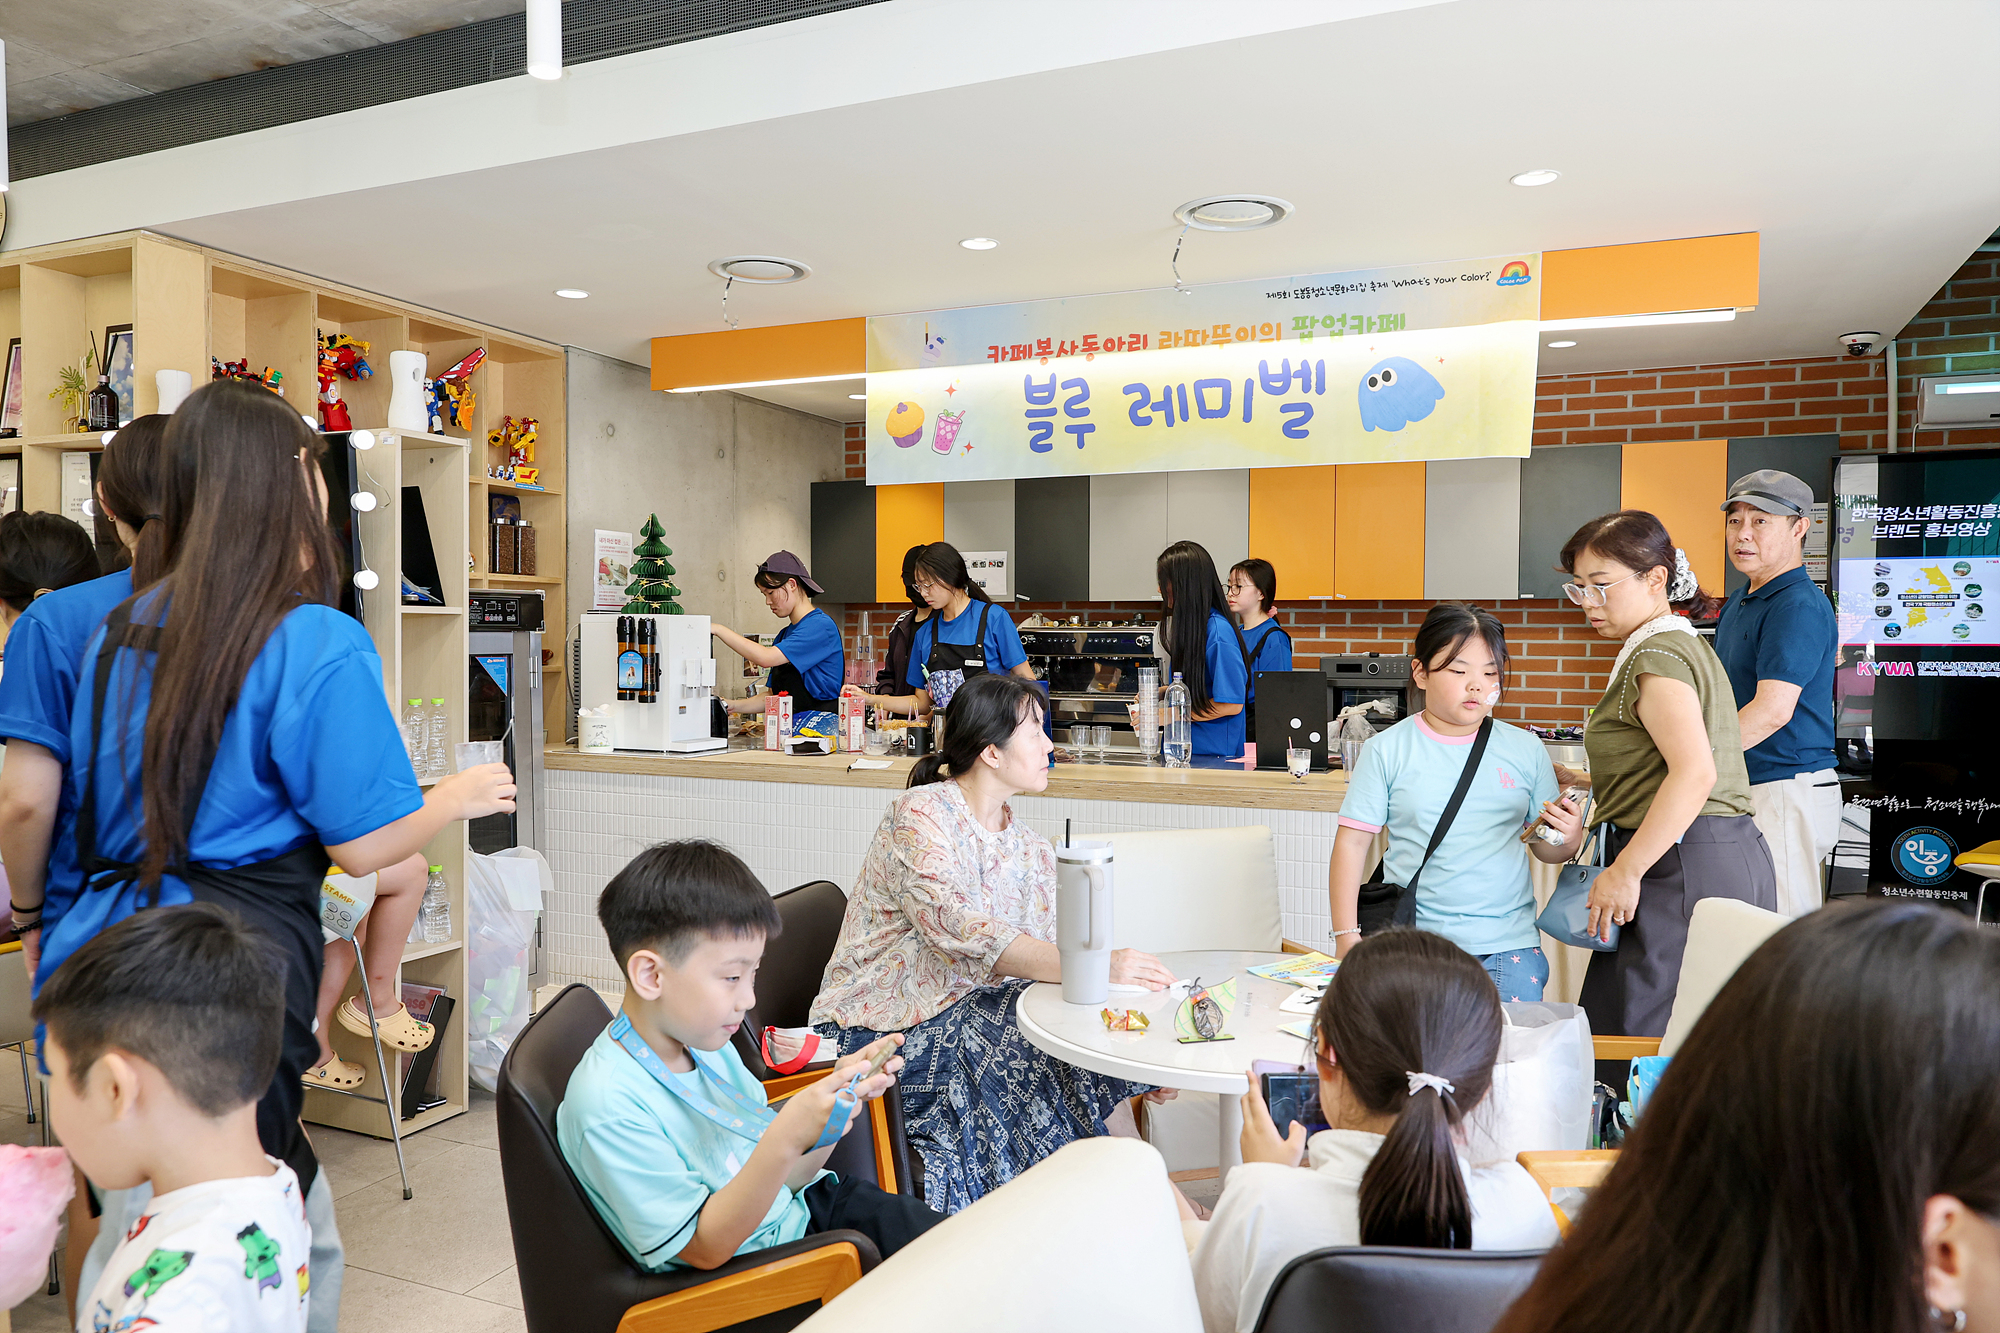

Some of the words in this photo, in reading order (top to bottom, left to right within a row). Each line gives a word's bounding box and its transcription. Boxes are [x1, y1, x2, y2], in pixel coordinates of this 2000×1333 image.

[1266, 290, 1290, 299] 제5회
[1293, 283, 1366, 299] 도봉동청소년문화의집
[1370, 281, 1388, 292] 축제
[987, 333, 1148, 365] 카페봉사동아리
[1158, 322, 1282, 349] 라따뚜이의
[1291, 312, 1405, 343] 팝업카페
[1024, 372, 1096, 453] 블루
[1122, 358, 1326, 439] 레미벨
[1851, 504, 2000, 522] 한국청소년활동진흥
[1871, 523, 1921, 538] 브랜드
[1924, 522, 1992, 538] 홍보영상
[1856, 661, 1915, 677] KYWA
[1496, 768, 1516, 788] LA
[324, 884, 355, 906] STAMP!
[1881, 886, 1968, 901] 청소년수련활동인증제
